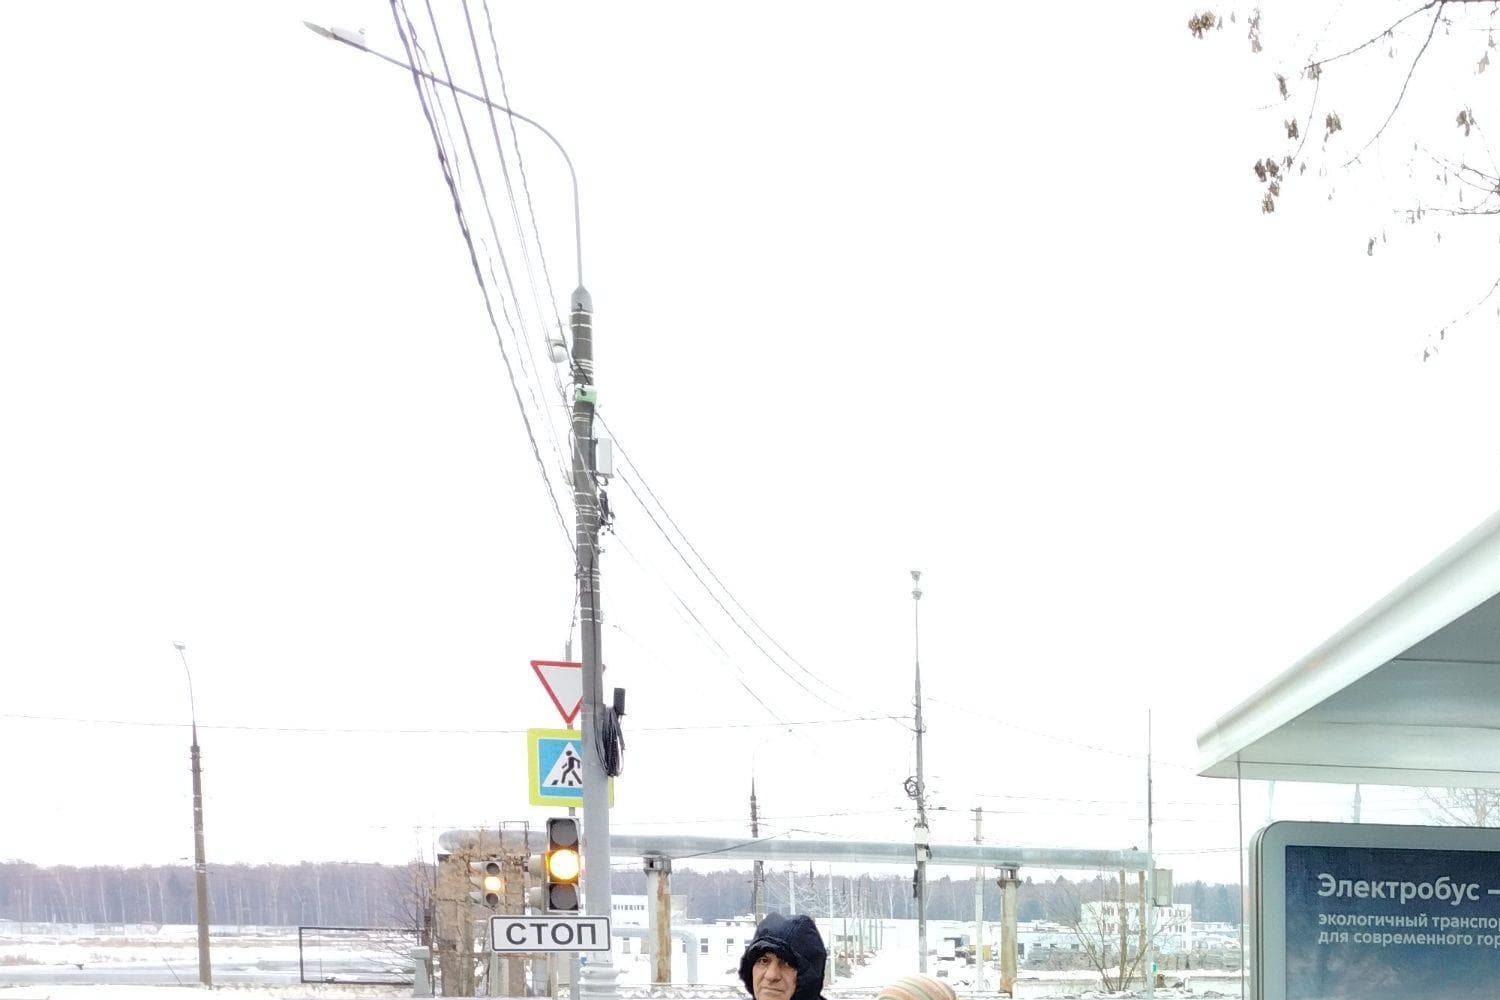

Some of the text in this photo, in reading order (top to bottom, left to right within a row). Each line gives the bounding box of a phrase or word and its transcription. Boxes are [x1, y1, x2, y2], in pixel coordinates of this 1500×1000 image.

[1317, 873, 1480, 906] Электробус
[1318, 913, 1428, 928] экологичный
[505, 922, 597, 945] СТОП
[1318, 931, 1349, 945] для
[1353, 932, 1472, 947] современного
